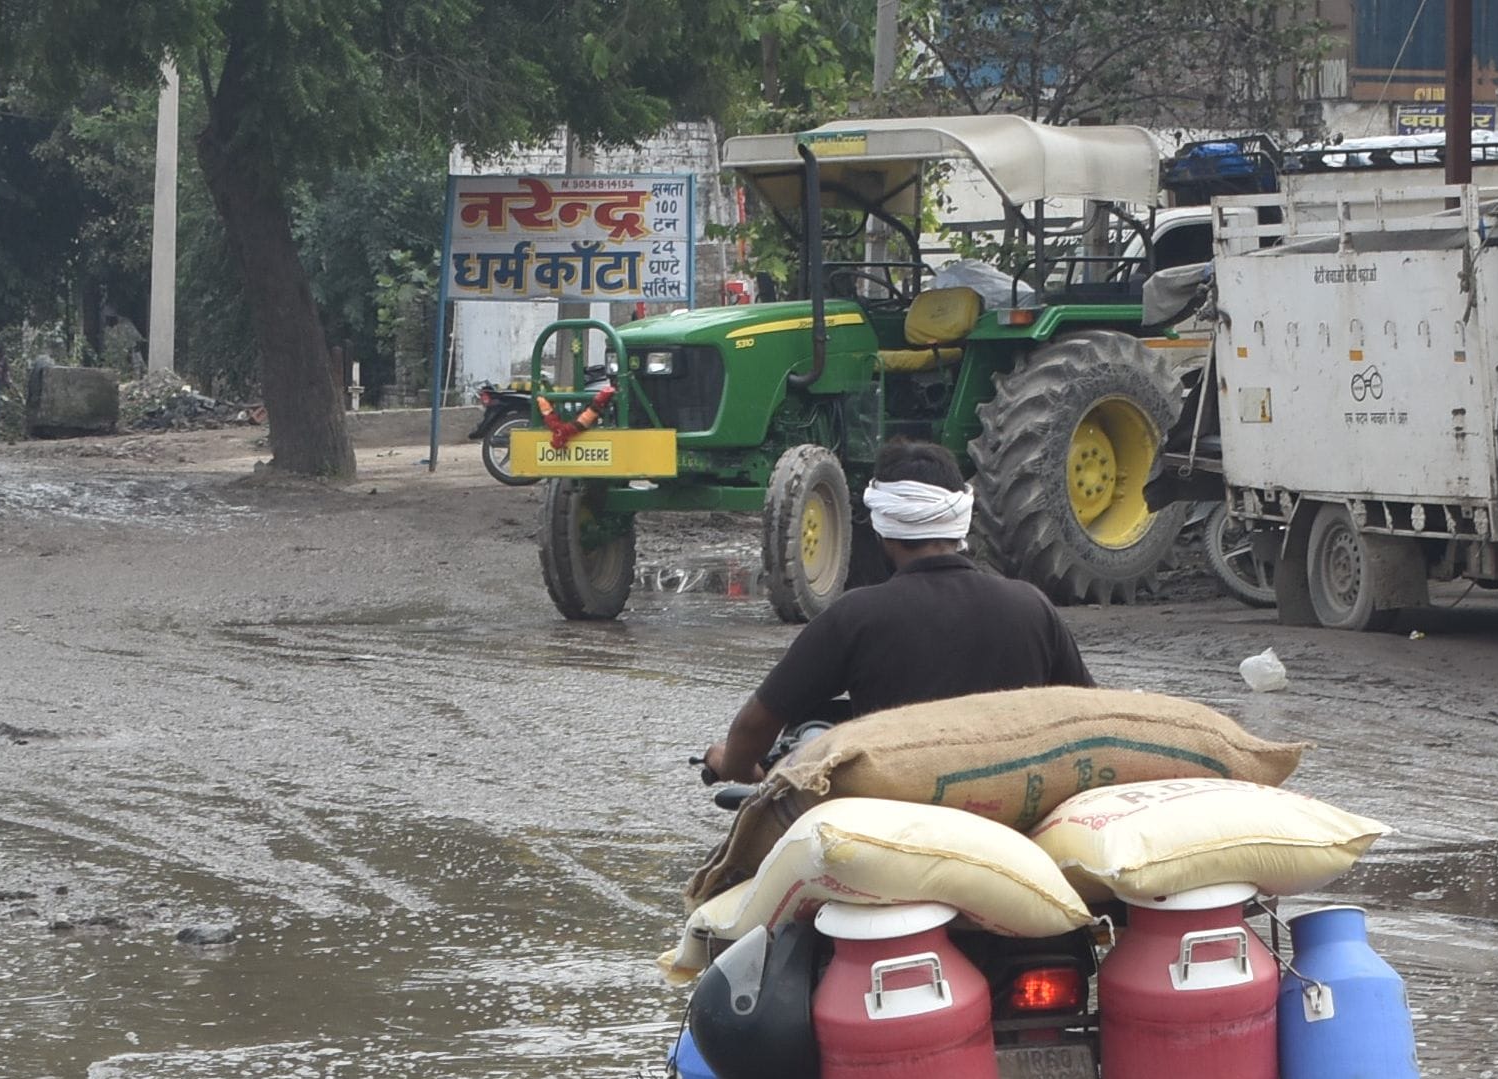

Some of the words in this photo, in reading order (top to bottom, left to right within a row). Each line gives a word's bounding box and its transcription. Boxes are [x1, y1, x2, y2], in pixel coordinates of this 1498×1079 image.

[651, 182, 685, 199] क्षमता
[458, 178, 651, 242] नरेन्द्र
[655, 200, 678, 214] 100
[653, 217, 680, 232] टन
[651, 240, 676, 255] 24
[452, 241, 535, 294] धर्म
[648, 256, 680, 276] घण्टे
[642, 276, 681, 298] सर्विस
[538, 446, 571, 462] JOHN
[575, 446, 610, 462] DEERE
